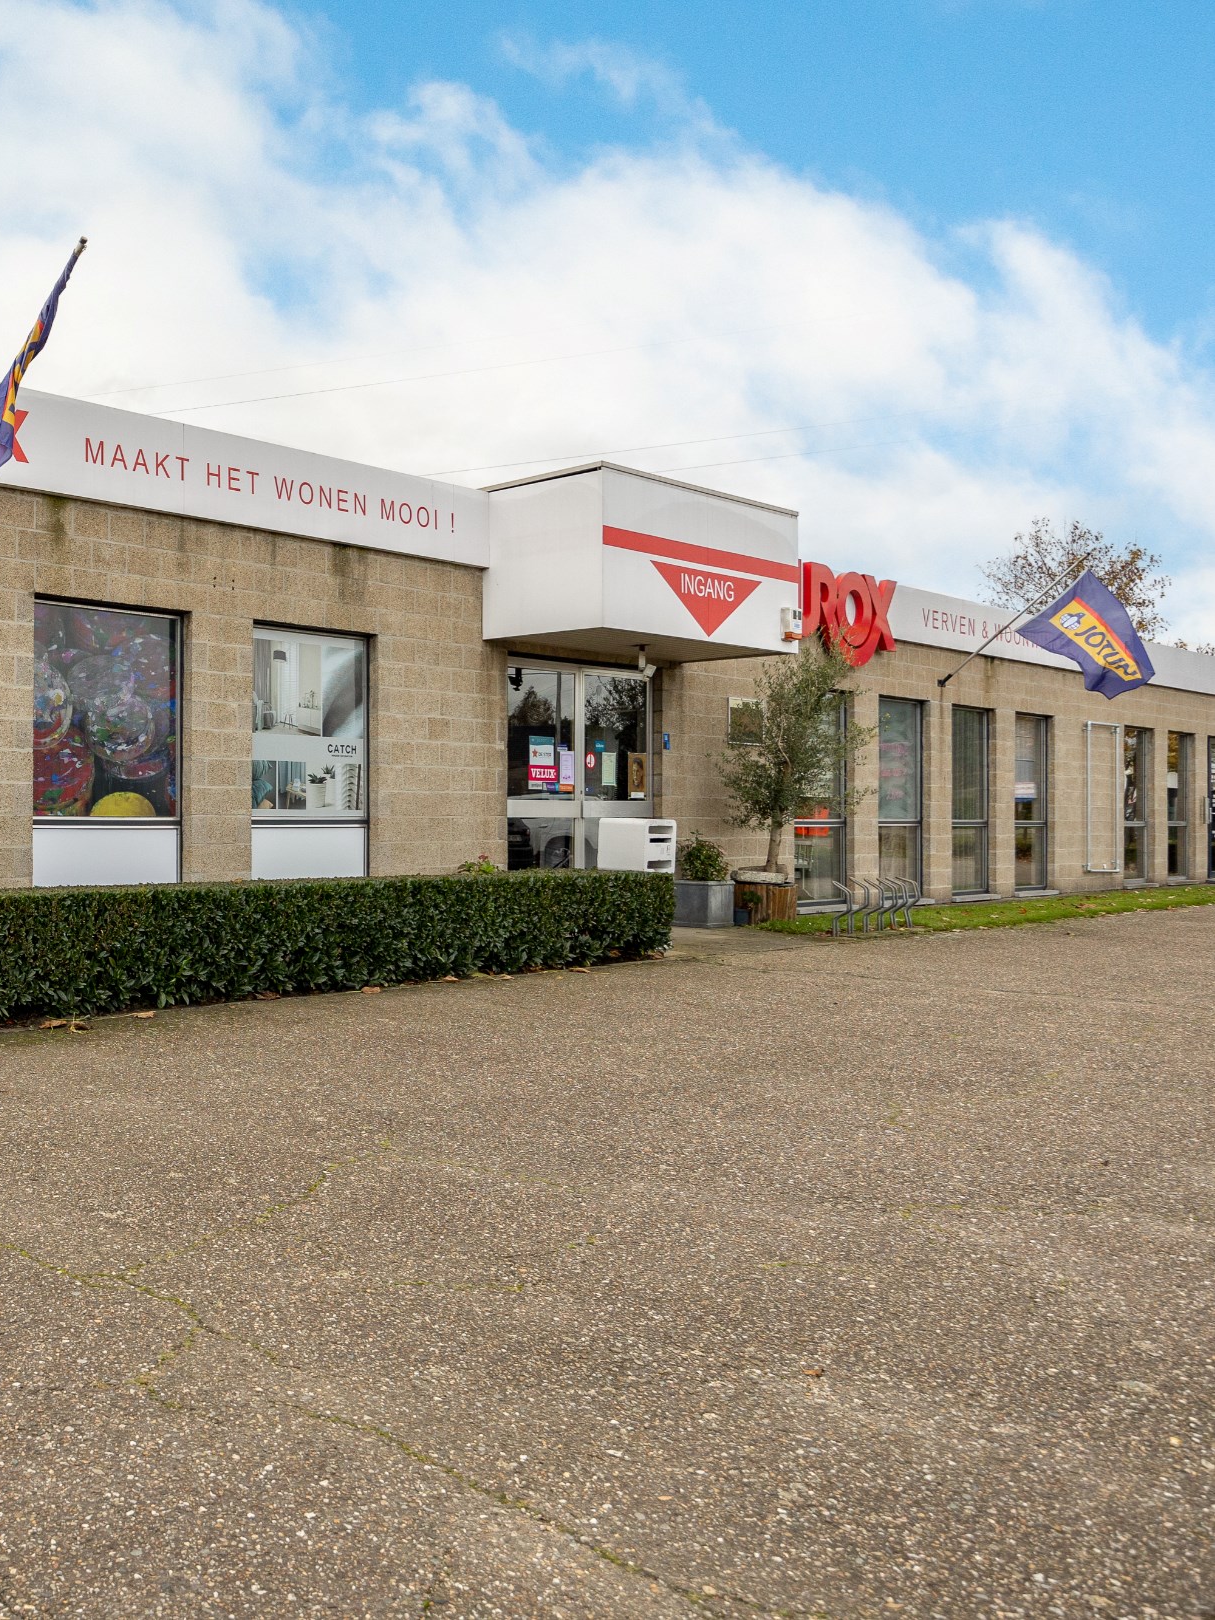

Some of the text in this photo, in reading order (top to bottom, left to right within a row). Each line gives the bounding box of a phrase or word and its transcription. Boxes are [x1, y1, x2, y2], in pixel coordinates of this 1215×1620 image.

[84, 437, 455, 533] MAAKT HET WONEN MOOI !
[680, 572, 735, 602] INGANG
[802, 561, 898, 667] ROX
[921, 607, 976, 637] VERVEN
[981, 620, 989, 639] &
[1073, 625, 1139, 676] JOTUN
[327, 744, 357, 754] CATCH
[531, 768, 556, 779] VELUX
